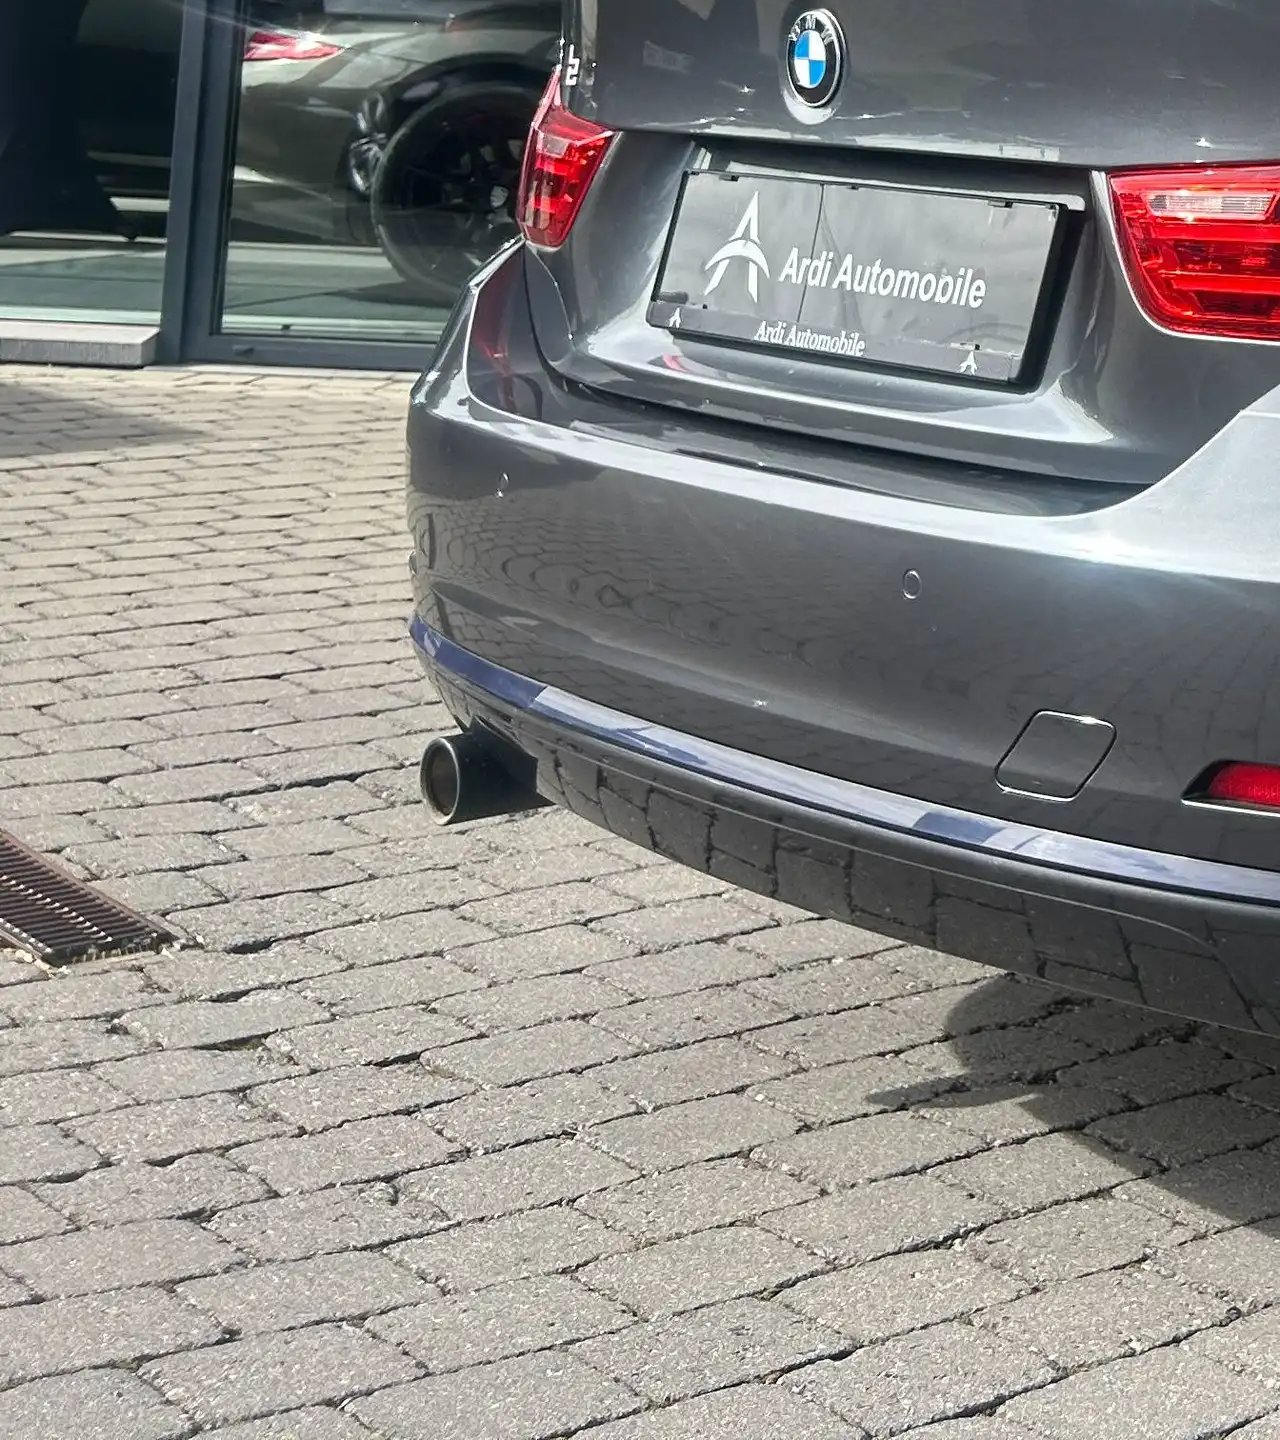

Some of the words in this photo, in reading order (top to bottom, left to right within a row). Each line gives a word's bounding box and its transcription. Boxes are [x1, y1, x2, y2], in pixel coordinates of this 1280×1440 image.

[778, 247, 833, 288] Ardi
[832, 253, 987, 308] Automobile
[754, 320, 787, 344] Ardi
[783, 325, 866, 357] Automobile
